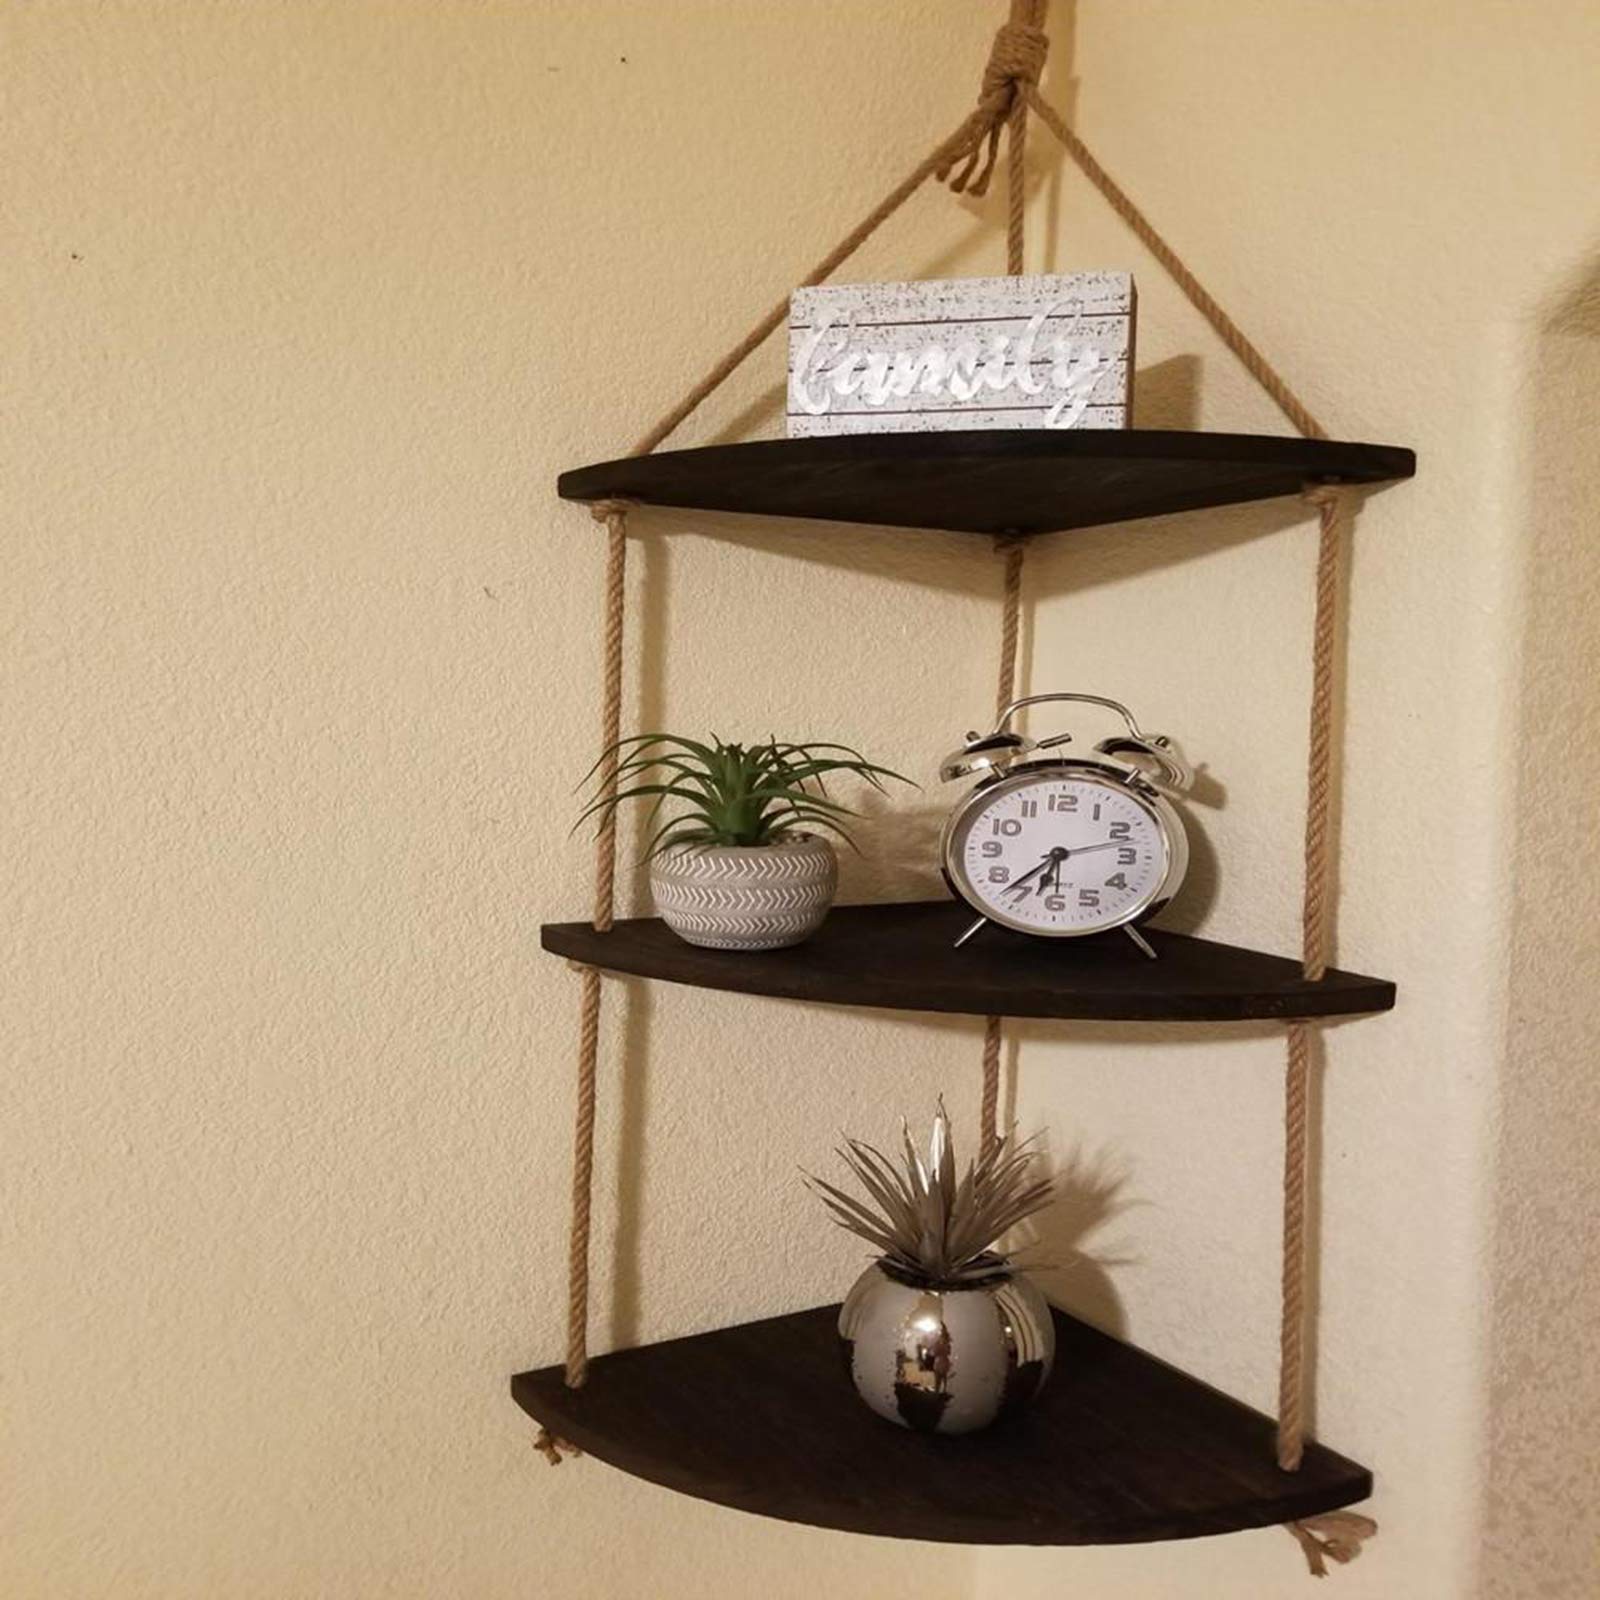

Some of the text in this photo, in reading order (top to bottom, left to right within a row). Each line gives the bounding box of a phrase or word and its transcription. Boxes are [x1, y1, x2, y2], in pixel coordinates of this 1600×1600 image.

[794, 300, 1118, 428] family
[1022, 801, 1037, 817] 11
[1049, 794, 1077, 812] 12
[1094, 804, 1101, 821] 1
[993, 819, 1022, 836] 10
[1110, 822, 1131, 840] 2
[982, 841, 1002, 858] 9
[1118, 848, 1136, 865] 3
[989, 866, 1009, 883] 8
[1105, 873, 1128, 890] 4
[1012, 885, 1033, 903] 7
[1079, 889, 1100, 907] 5
[1045, 895, 1065, 911] 6
